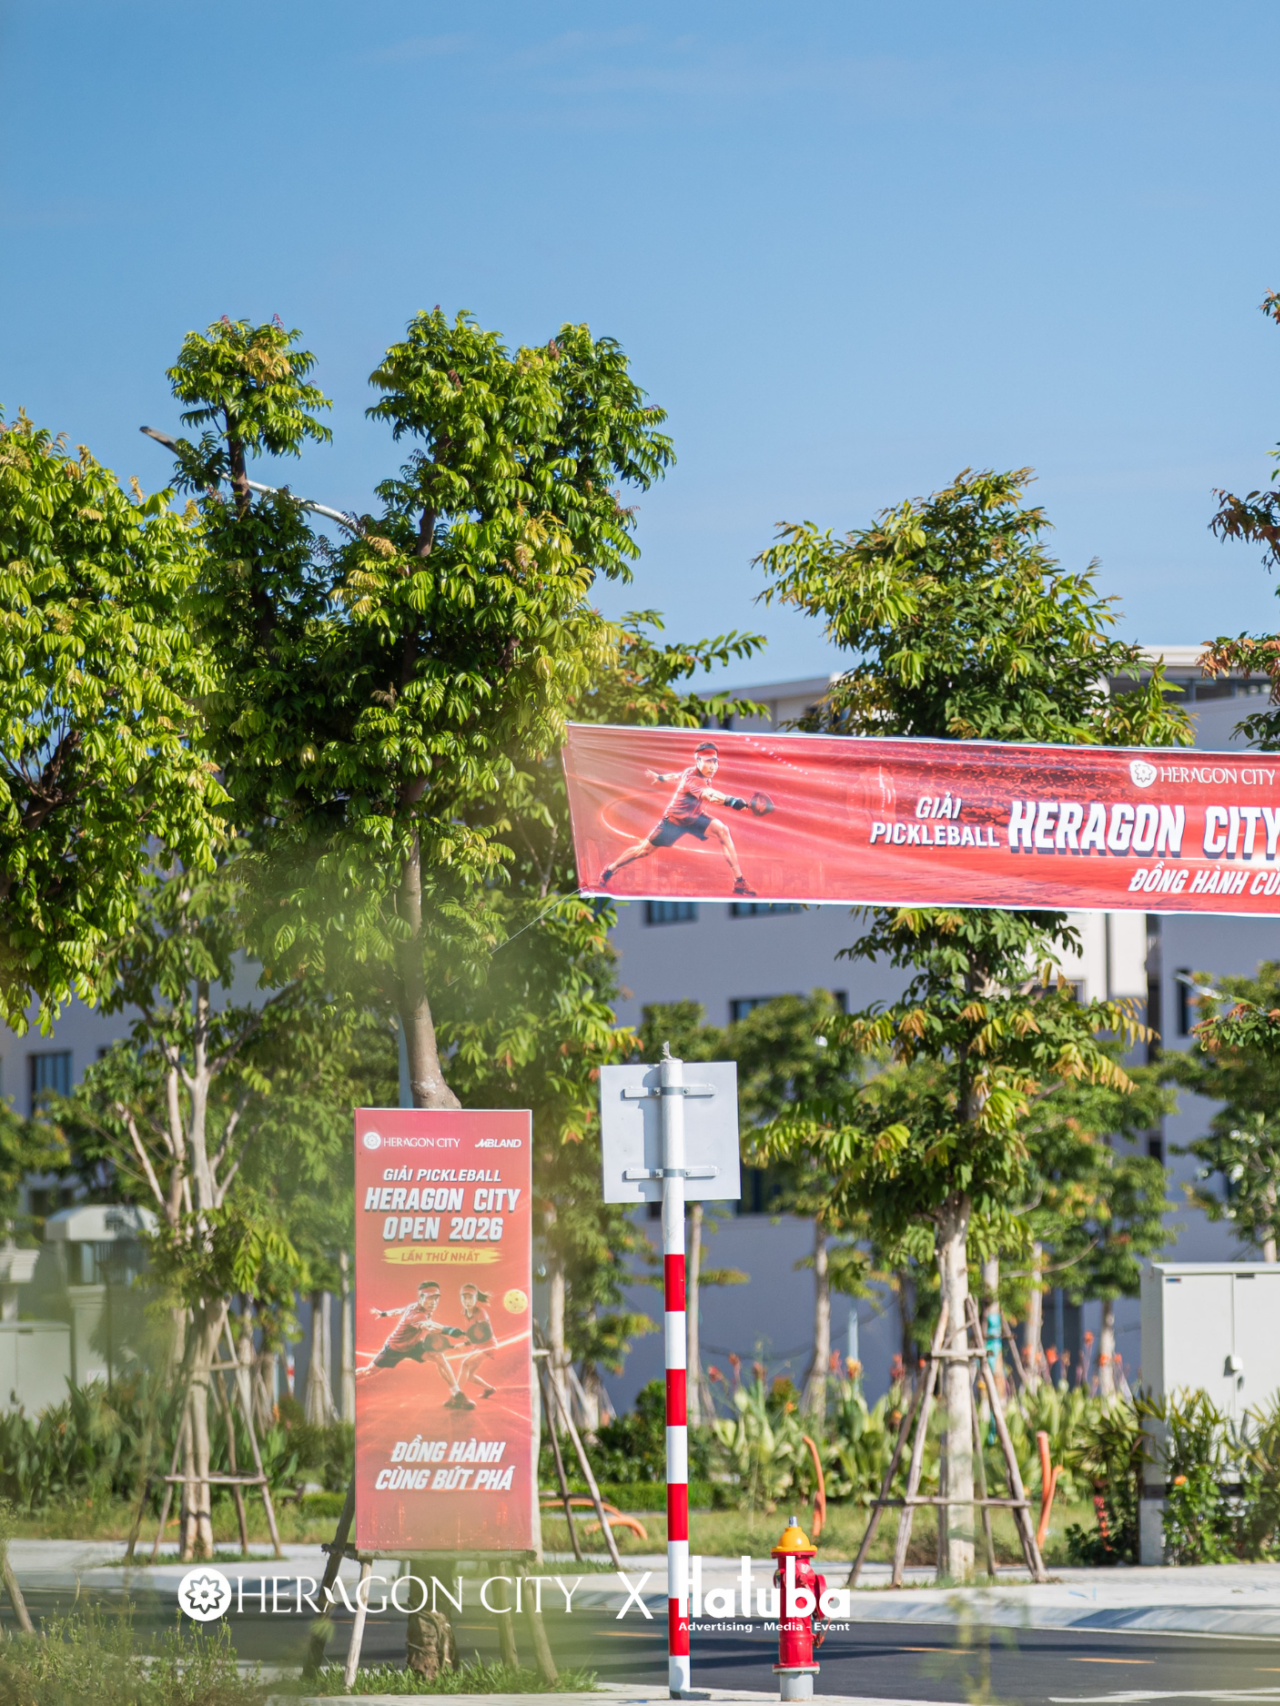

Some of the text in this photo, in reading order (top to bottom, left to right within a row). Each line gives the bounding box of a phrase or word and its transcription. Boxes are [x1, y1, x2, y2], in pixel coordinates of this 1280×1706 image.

[1160, 766, 1276, 785] HERAGON CITY
[915, 792, 962, 819] GIẢI
[870, 821, 1000, 847] PICKLEBALL
[1008, 800, 1185, 857] HERAGON
[1128, 861, 1189, 893] ĐỒNG
[1189, 866, 1250, 895] HÀNH
[383, 1137, 460, 1148] HERAGON CITY
[475, 1139, 522, 1148] MBLAND
[383, 1165, 502, 1182] GIẢI PICKLEBALL
[365, 1187, 521, 1213] HERAGON CITY
[383, 1216, 504, 1241] OPEN 2026
[426, 1250, 449, 1262] THỨ
[390, 1434, 506, 1462] ĐỒNG HÀNH
[375, 1465, 516, 1490] CÙNG BỨT PHÁ
